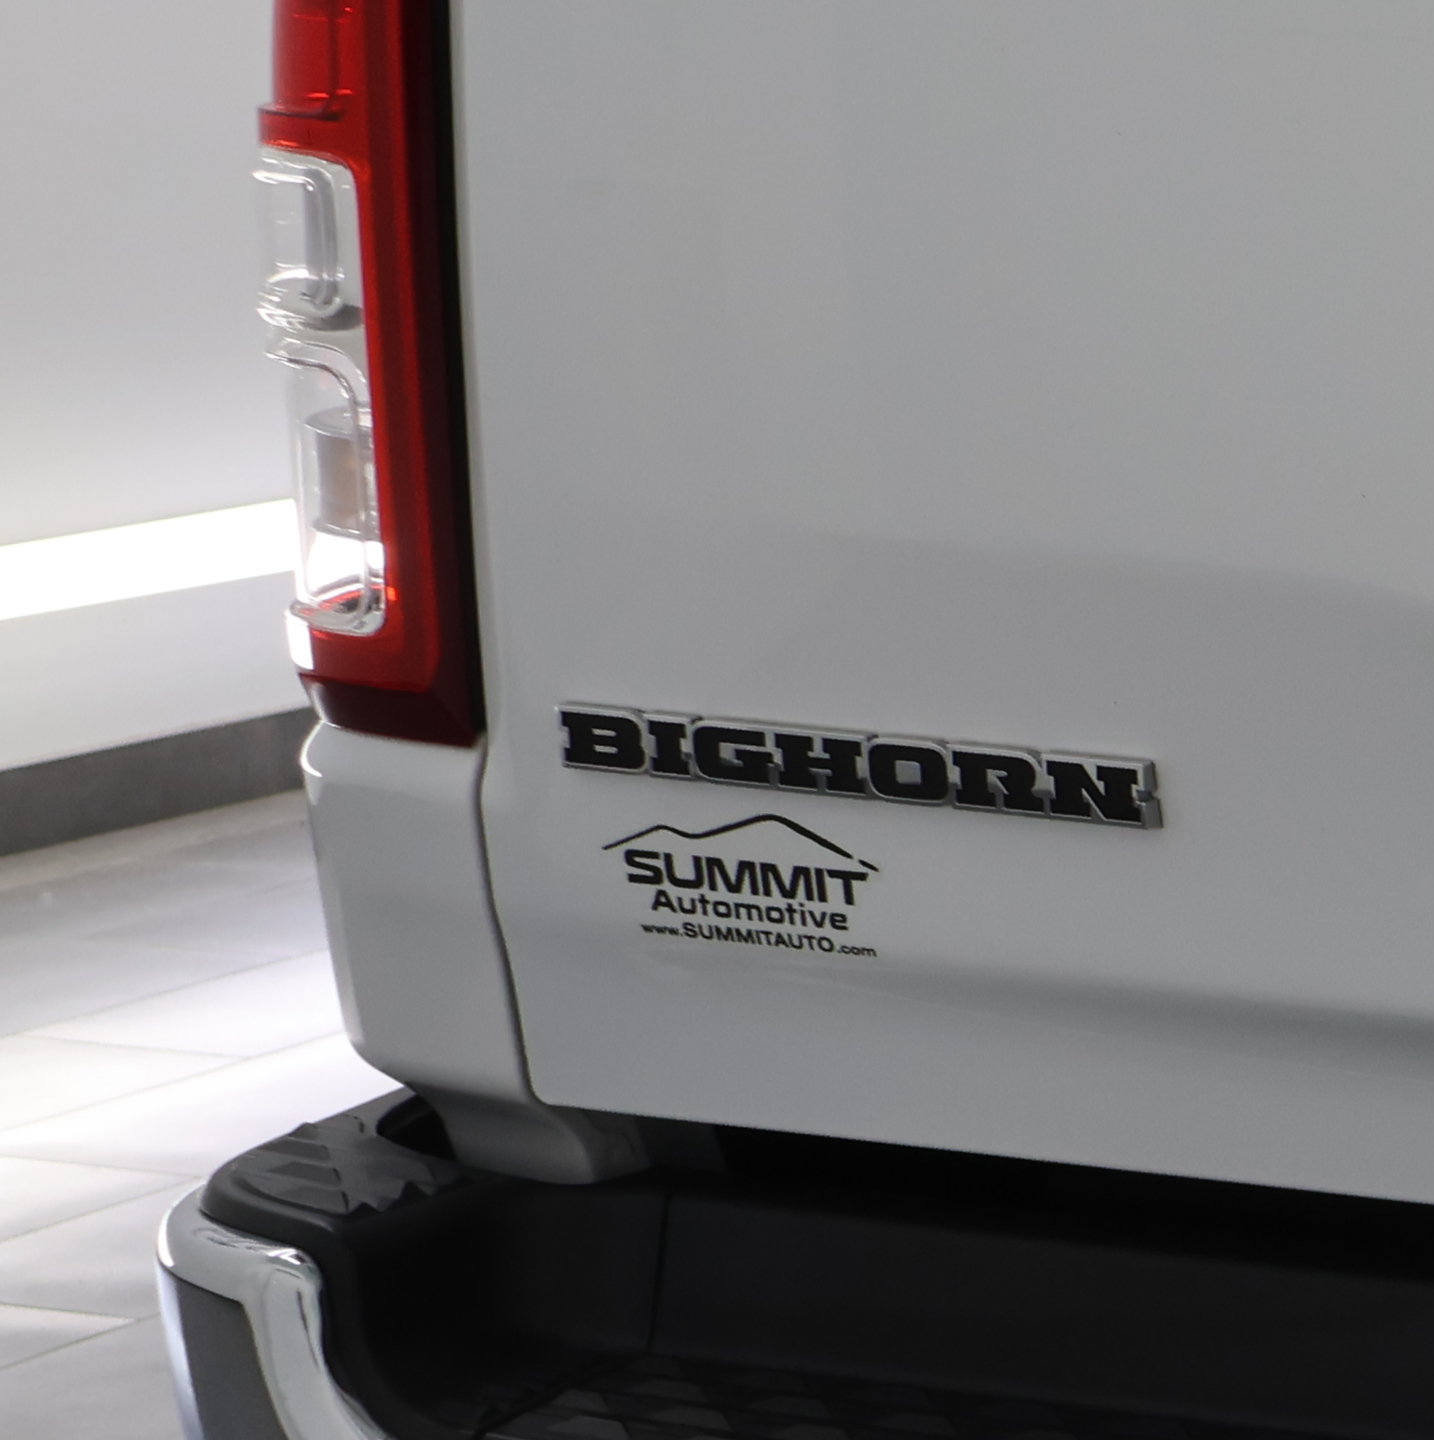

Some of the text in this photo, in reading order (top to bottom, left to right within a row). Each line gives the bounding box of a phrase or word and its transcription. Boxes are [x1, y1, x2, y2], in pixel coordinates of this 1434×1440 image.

[556, 703, 1162, 828] BIGHORN
[624, 849, 869, 906] SUMMIT
[651, 889, 849, 931] Automotive
[640, 922, 878, 958] www.SUMMITAUTO.com
